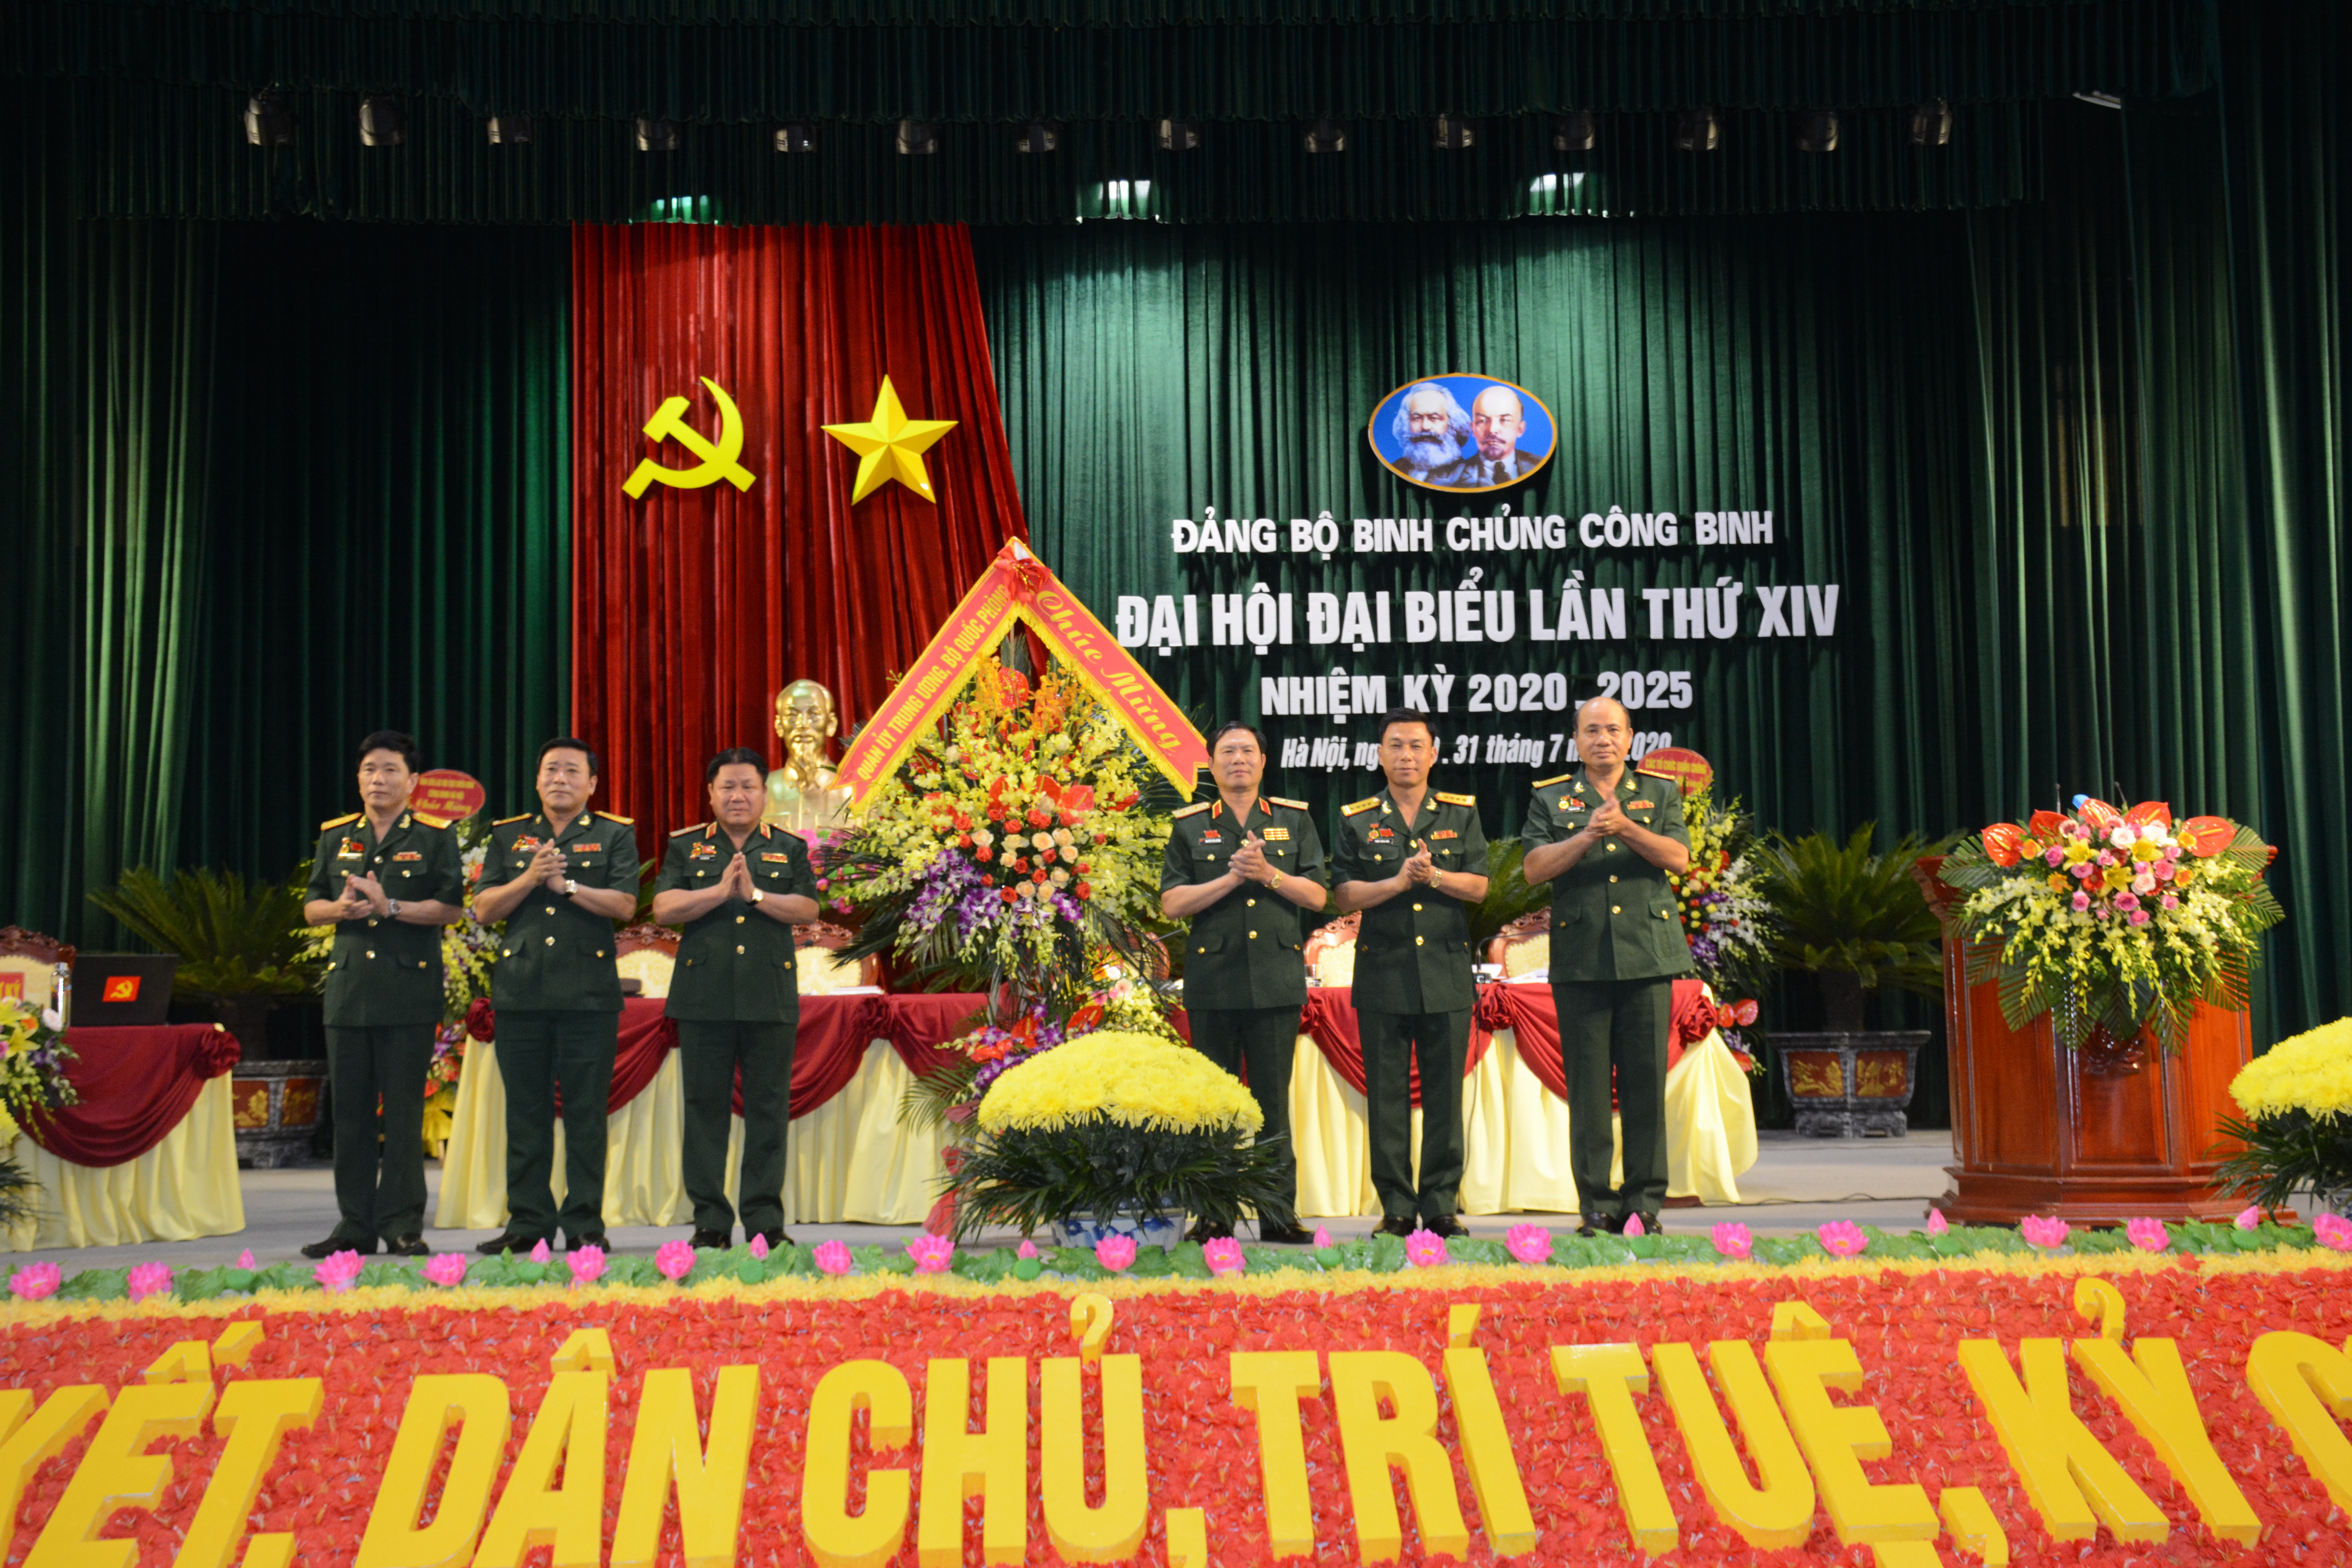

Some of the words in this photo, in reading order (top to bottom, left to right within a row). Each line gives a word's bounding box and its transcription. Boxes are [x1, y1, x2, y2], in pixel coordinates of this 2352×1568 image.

[1171, 506, 1277, 553] ĐẢNG
[1291, 510, 1339, 560] BỘ
[1354, 518, 1433, 552] BINH
[1446, 503, 1566, 552] CHỦNG
[1579, 505, 1678, 548] CÔNG
[1695, 511, 1773, 545] BINH
[1116, 595, 1200, 656] ĐẠI
[1212, 582, 1293, 655] HỘI
[1307, 591, 1391, 652] ĐẠI
[1405, 567, 1515, 643] BIỂU
[1530, 570, 1626, 641] LẦN
[1642, 576, 1743, 639] THỨ
[1755, 584, 1840, 638] XIV
[954, 619, 985, 652] QUỐC
[940, 645, 966, 668] BỘ
[1036, 591, 1103, 664] Chúc
[1101, 668, 1181, 753] Mừng
[915, 665, 953, 700] ƯƠNG,
[1261, 667, 1387, 724] NHIỆM
[1404, 664, 1455, 713] KỲ
[1468, 672, 1567, 713] 2020
[1597, 671, 1693, 709] 2025
[887, 695, 926, 734] TRUNG
[871, 728, 897, 750] ỦY
[1280, 736, 1309, 768] Hà
[1310, 735, 1350, 773] Nội,
[1453, 734, 1479, 764] 31
[1485, 732, 1545, 768] tháng
[1549, 733, 1564, 763] 7
[857, 745, 886, 780] QUÂN
[354, 1328, 761, 1568] DÂN
[1229, 1303, 1536, 1568] TRÍ
[1957, 1277, 2263, 1551] KỶ
